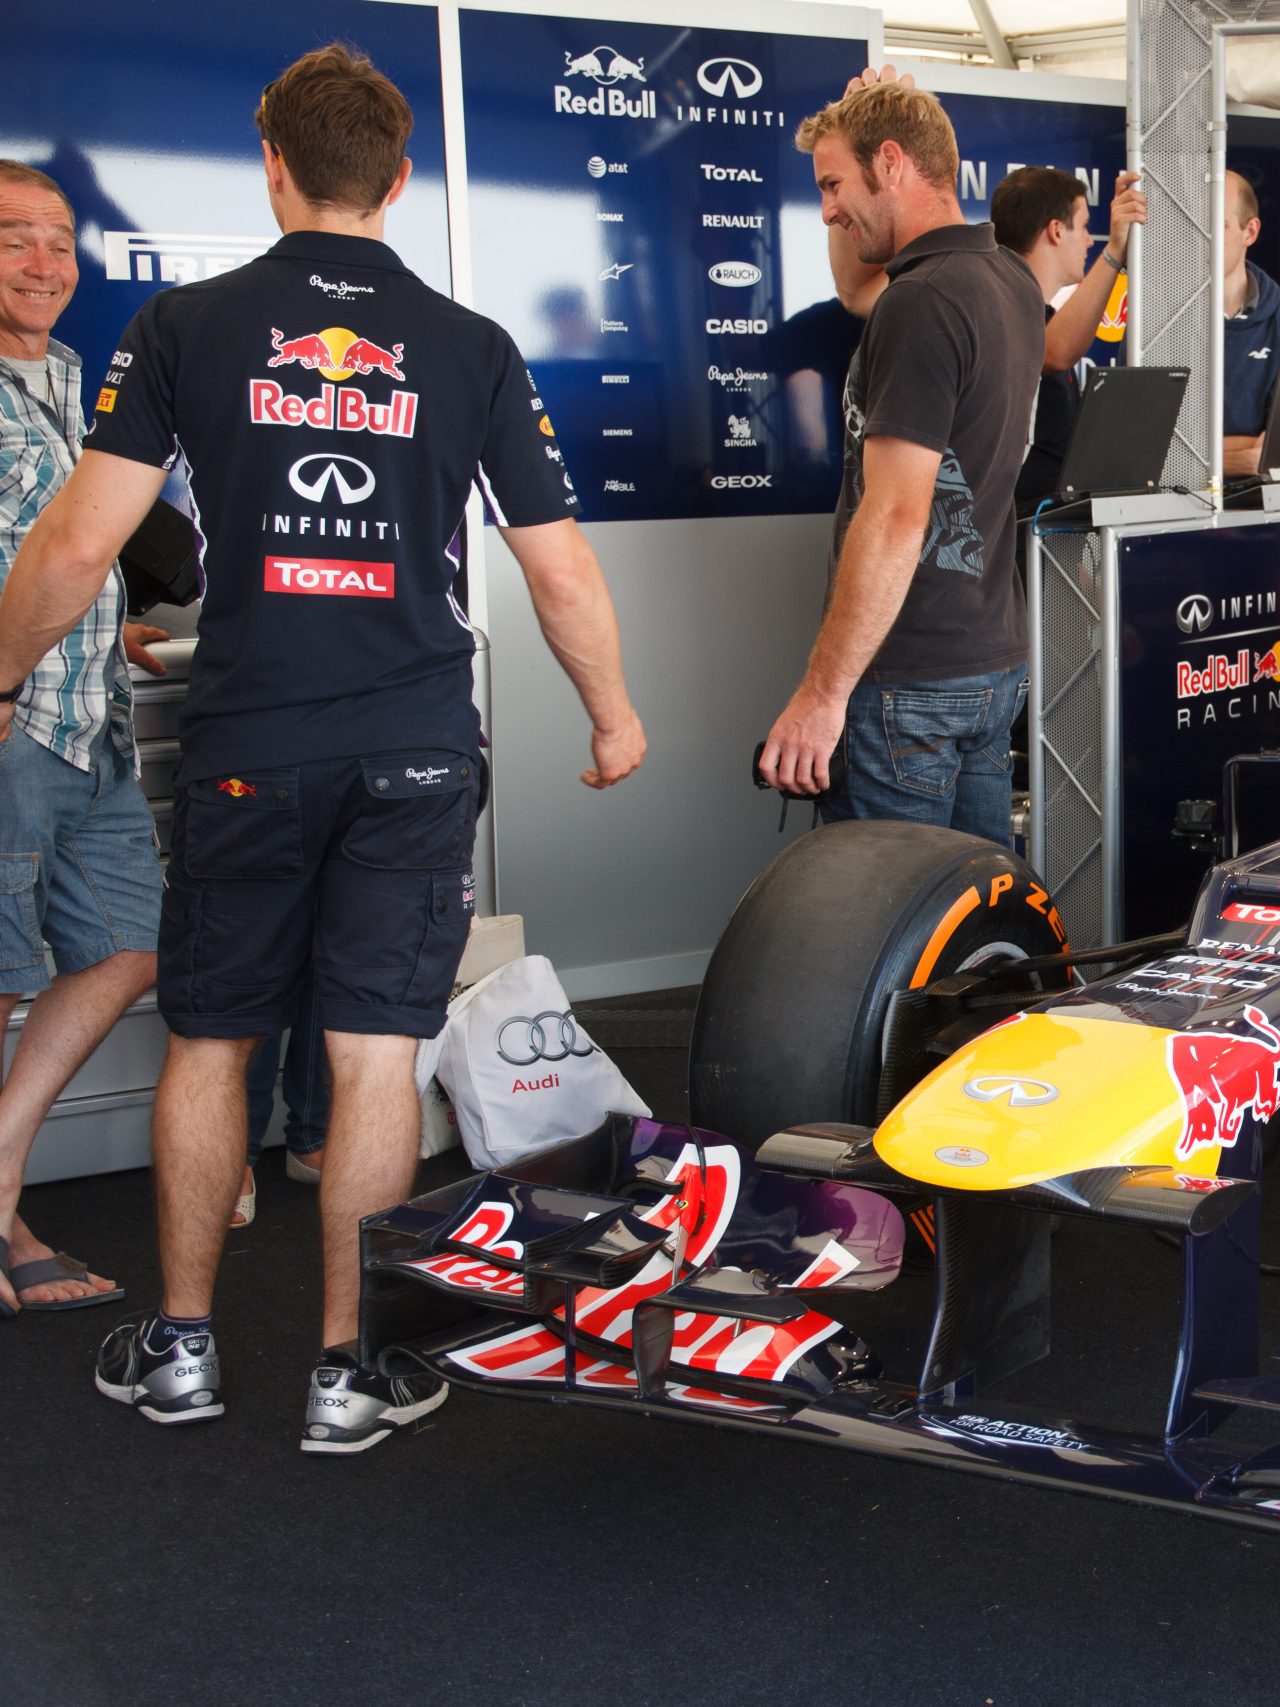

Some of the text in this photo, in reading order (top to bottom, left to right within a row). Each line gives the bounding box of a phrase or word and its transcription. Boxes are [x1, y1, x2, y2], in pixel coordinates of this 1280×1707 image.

[554, 86, 657, 119] Red Bull
[676, 105, 785, 127] INFINITI
[608, 163, 629, 174] at&t
[700, 163, 764, 183] TOTAL
[596, 212, 624, 222] SONAX
[702, 214, 765, 229] RENAULT
[104, 231, 287, 281] PIRE
[310, 274, 376, 295] Pepe Jeans
[722, 269, 756, 281] RAUCH
[705, 319, 769, 335] CASIO
[707, 365, 769, 386] Pepe Jeans
[250, 379, 419, 439] Red Bull
[603, 429, 633, 437] SIEMENS
[724, 439, 757, 447] SINGHA
[710, 475, 773, 490] GEOX
[262, 513, 400, 541] INFINITI
[273, 562, 387, 592] TOTAL
[1176, 649, 1250, 700] Red Bull
[989, 873, 1014, 908] P
[1132, 969, 1268, 990] CASIO
[512, 1073, 560, 1093] Audi
[174, 1361, 217, 1378] GEOX
[972, 1424, 1022, 1438] ROAD
[1021, 1433, 1091, 1451] SAFETY
[989, 1420, 1070, 1440] ACTION
